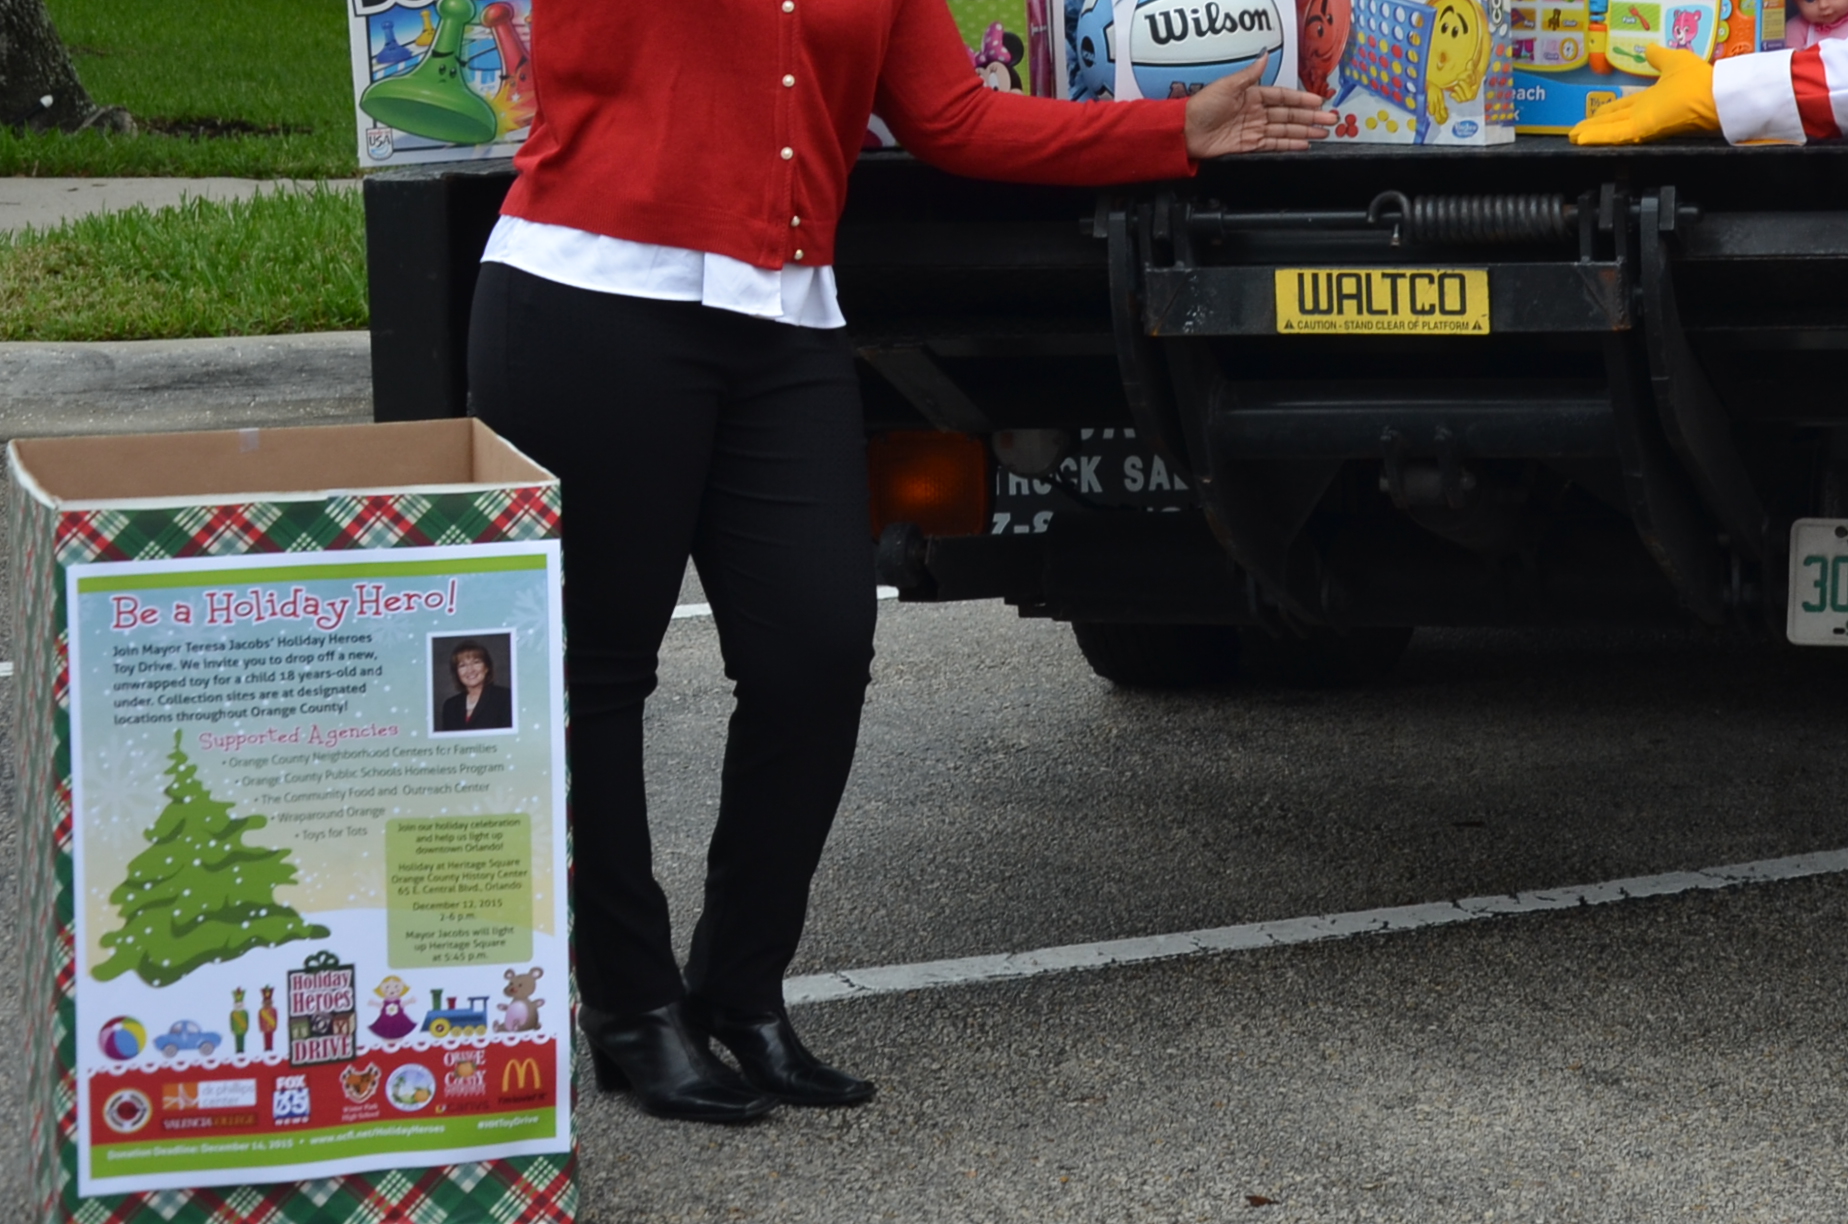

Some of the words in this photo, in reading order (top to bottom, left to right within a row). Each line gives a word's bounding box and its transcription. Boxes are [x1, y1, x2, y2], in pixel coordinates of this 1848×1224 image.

[1144, 3, 1272, 45] Wilson
[1512, 85, 1546, 101] each
[369, 135, 392, 147] USA
[1297, 272, 1467, 316] WALTCO
[1297, 321, 1337, 330] CAUTION
[1344, 321, 1374, 330] STAND
[1375, 321, 1405, 330] CLEAR
[1407, 321, 1421, 330] OF
[1422, 321, 1469, 331] PLATFORM
[112, 596, 158, 628] Be
[174, 603, 191, 623] a
[205, 588, 350, 630] Holiday
[355, 579, 456, 616] Hero!
[113, 645, 139, 657] Join
[142, 644, 182, 657] Mayor
[186, 640, 225, 653] Teresa
[278, 633, 326, 647] Holiday
[328, 633, 372, 645] Heroes
[113, 663, 135, 676] Toy
[138, 661, 177, 673] Drive.
[180, 659, 199, 670] We
[204, 658, 239, 669] invite
[243, 656, 265, 669] you
[269, 656, 282, 665] to
[285, 652, 314, 665] drop
[317, 651, 336, 662] off
[338, 652, 345, 661] a
[348, 651, 378, 661] new,
[113, 677, 186, 692] unwrapped
[190, 678, 210, 689] toy
[213, 675, 231, 685] for
[234, 676, 241, 685] a
[245, 672, 276, 683] child
[280, 671, 295, 681] 18
[298, 667, 356, 683] years-old
[360, 666, 382, 676] and
[199, 727, 300, 751] Supported
[307, 724, 399, 747] Agencies
[293, 972, 351, 990] Holiday
[293, 990, 351, 1013] Heroes
[295, 1036, 351, 1061] DRIVE
